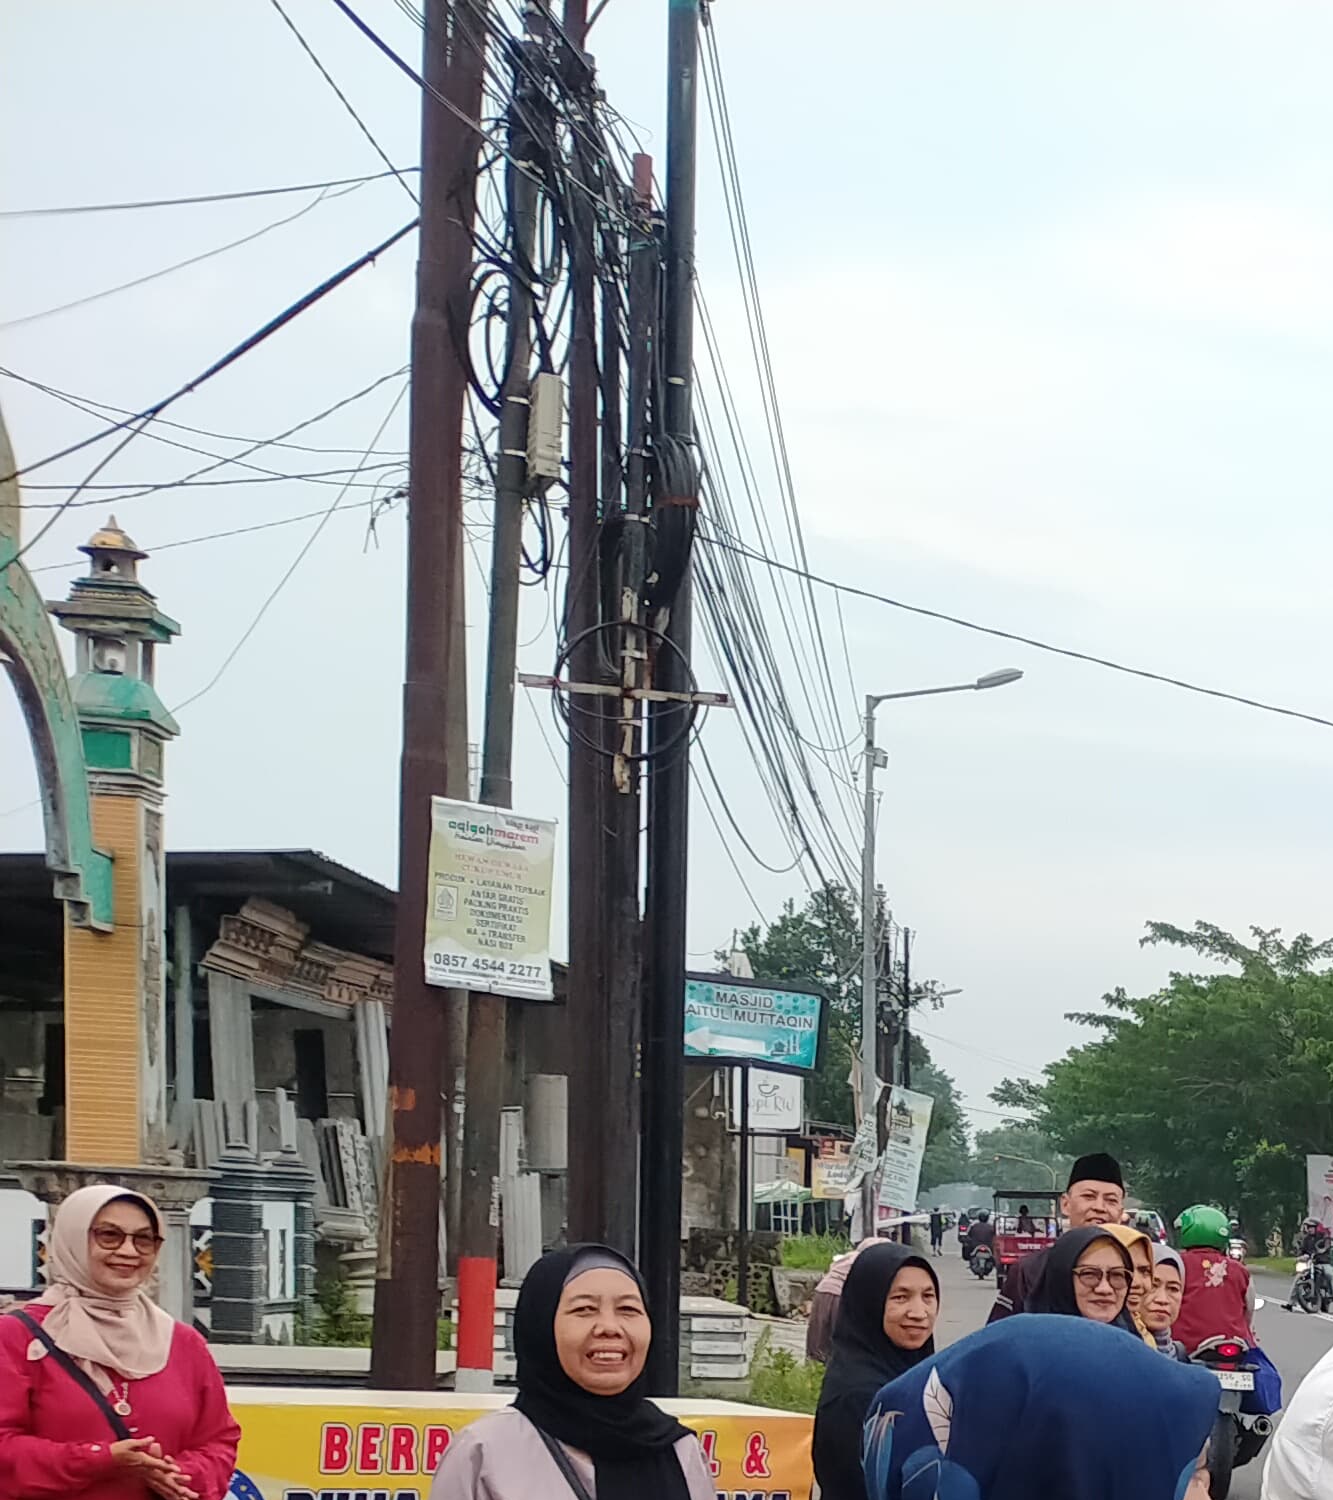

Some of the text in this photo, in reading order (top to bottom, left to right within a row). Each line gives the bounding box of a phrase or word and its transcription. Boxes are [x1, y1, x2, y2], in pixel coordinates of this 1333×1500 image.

[433, 952, 468, 969] 0857
[472, 957, 505, 973] 4544
[509, 963, 542, 978] 2277
[715, 991, 774, 1009] MASJID
[733, 1010, 814, 1030] MUTTAQIN
[743, 1431, 772, 1476] &
